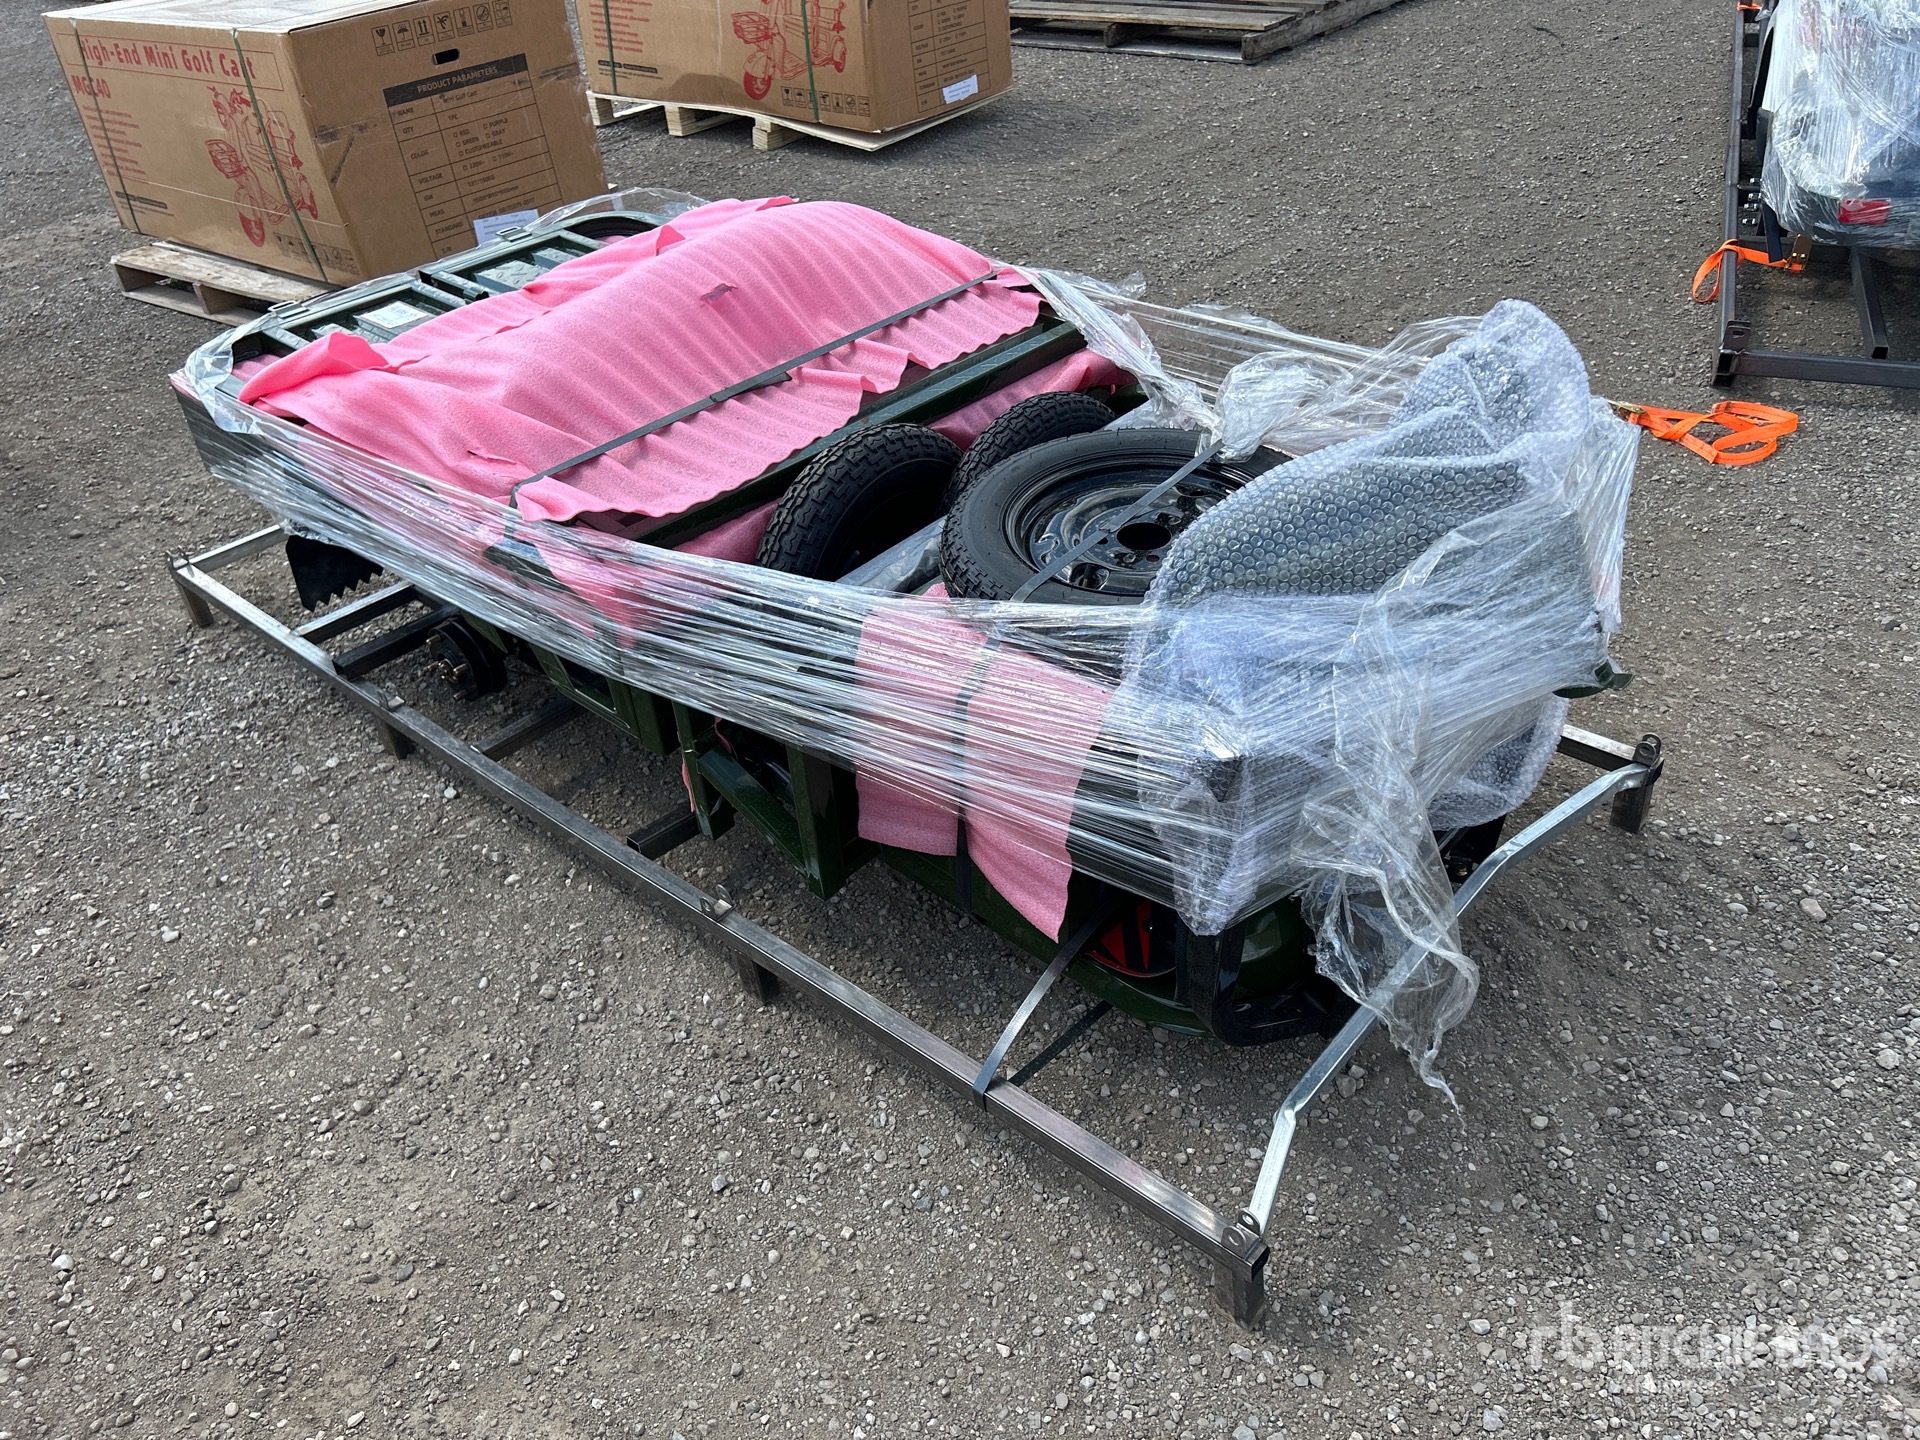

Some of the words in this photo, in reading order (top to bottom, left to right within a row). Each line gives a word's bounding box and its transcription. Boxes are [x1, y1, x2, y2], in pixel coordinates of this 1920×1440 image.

[80, 40, 142, 66] High-End
[143, 45, 178, 70] Mini
[181, 49, 215, 74] Golf
[218, 53, 256, 80] Cat
[417, 78, 451, 93] PRODUCT
[452, 66, 498, 84] PARAMETERS
[397, 106, 414, 117] NAME
[489, 117, 508, 127] PURPLE
[402, 126, 414, 134] QTY
[459, 128, 470, 137] RED
[462, 136, 480, 146] GREEN
[418, 173, 443, 185] VOLTAGE
[429, 208, 445, 218] MEAS
[435, 221, 464, 235] STANDARD
